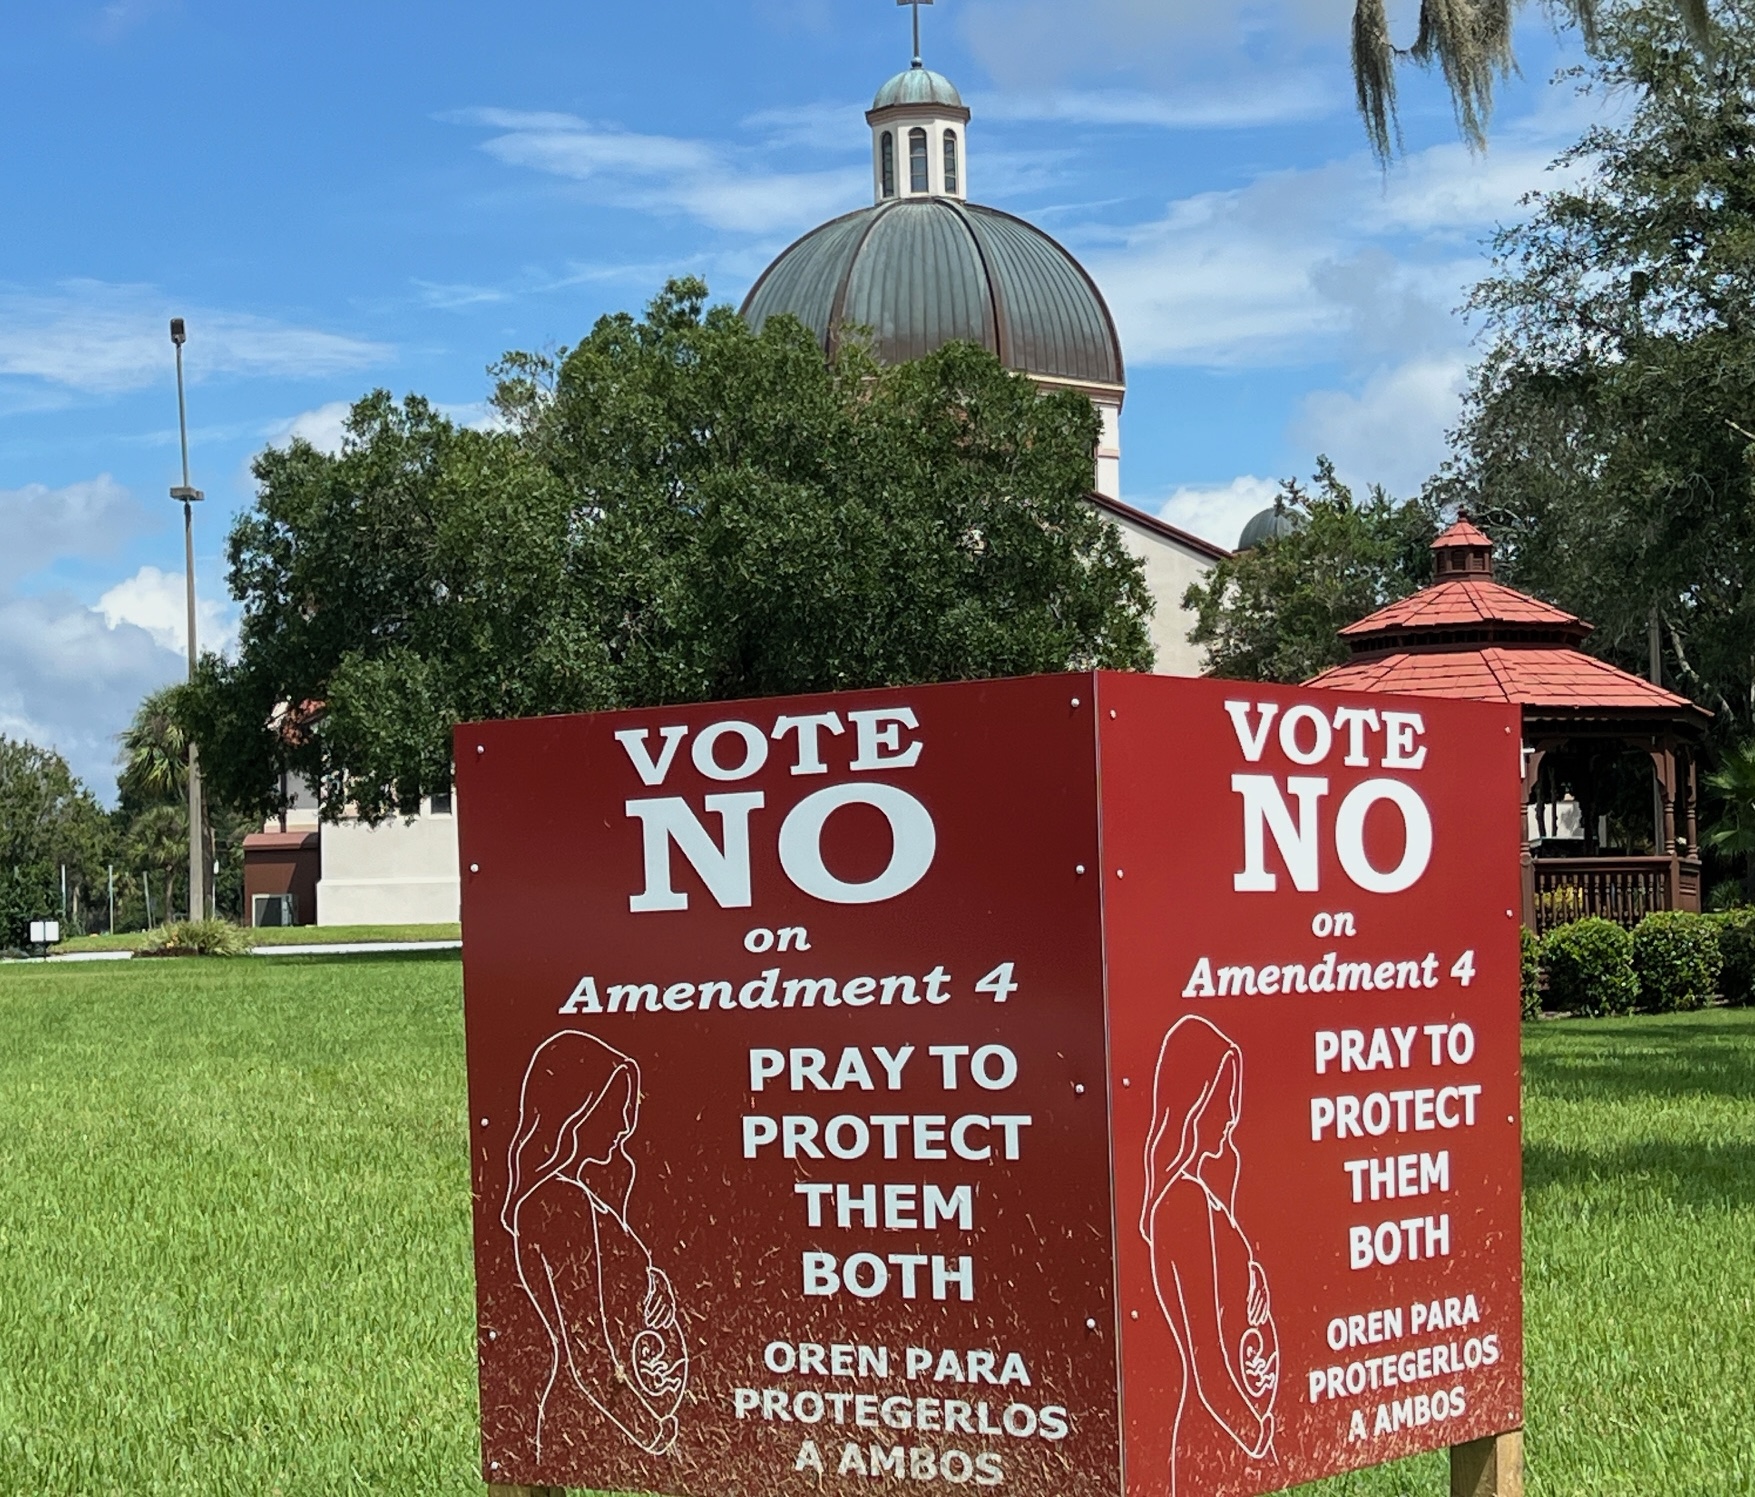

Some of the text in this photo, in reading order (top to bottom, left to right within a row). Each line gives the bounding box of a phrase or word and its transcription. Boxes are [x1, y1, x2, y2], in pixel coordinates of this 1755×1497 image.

[614, 706, 924, 787] VOTE
[1224, 700, 1428, 770] VOTE
[625, 782, 936, 913] NO
[1230, 773, 1433, 894] NO
[743, 926, 812, 953] on
[1311, 911, 1357, 938] on
[558, 962, 1018, 1015] Amendment 4
[1181, 949, 1476, 998] Amendment 4
[749, 1044, 1018, 1092] PRAY TO
[1314, 1022, 1475, 1074] PRAY TO
[742, 1114, 1032, 1160] PROTECT
[1310, 1084, 1482, 1141] PROTECT
[1343, 1150, 1450, 1203] THEM
[794, 1183, 973, 1231] THEM
[1349, 1213, 1450, 1270] BOTH
[802, 1249, 974, 1301] BOTH
[1326, 1293, 1481, 1351] OREN PARA
[763, 1341, 1031, 1387] OREN PARA
[1307, 1333, 1500, 1404] PROTEGERLOS
[733, 1386, 1069, 1441] PROTEGERLOS
[1347, 1386, 1467, 1443] A AMBOS
[794, 1439, 1005, 1487] A AMBOS
